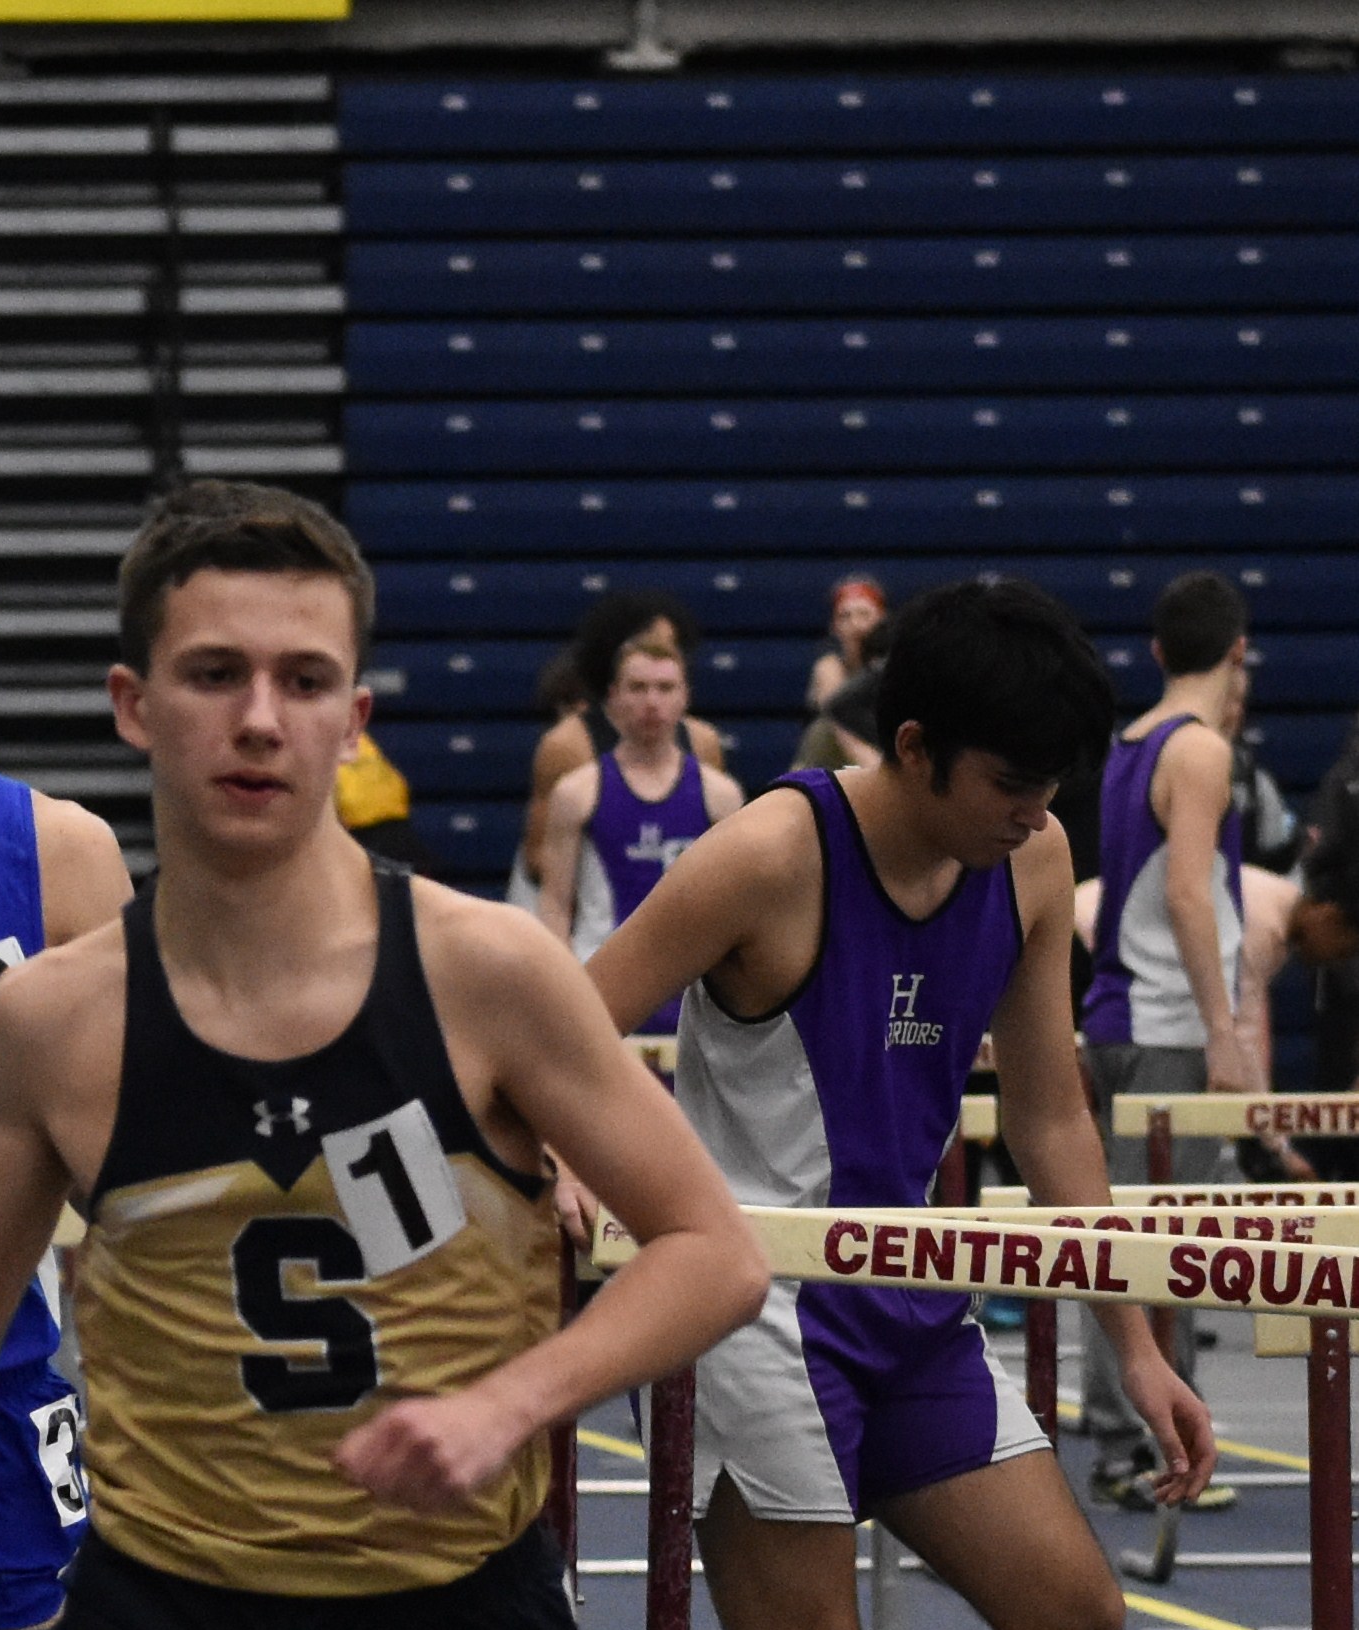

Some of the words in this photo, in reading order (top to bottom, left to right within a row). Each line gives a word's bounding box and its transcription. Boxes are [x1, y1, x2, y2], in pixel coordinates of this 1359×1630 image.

[889, 974, 925, 1018] H
[348, 1128, 433, 1251] 1
[230, 1216, 379, 1413] S
[823, 1217, 1129, 1294] CENTRAL
[1167, 1242, 1359, 1310] SQUA
